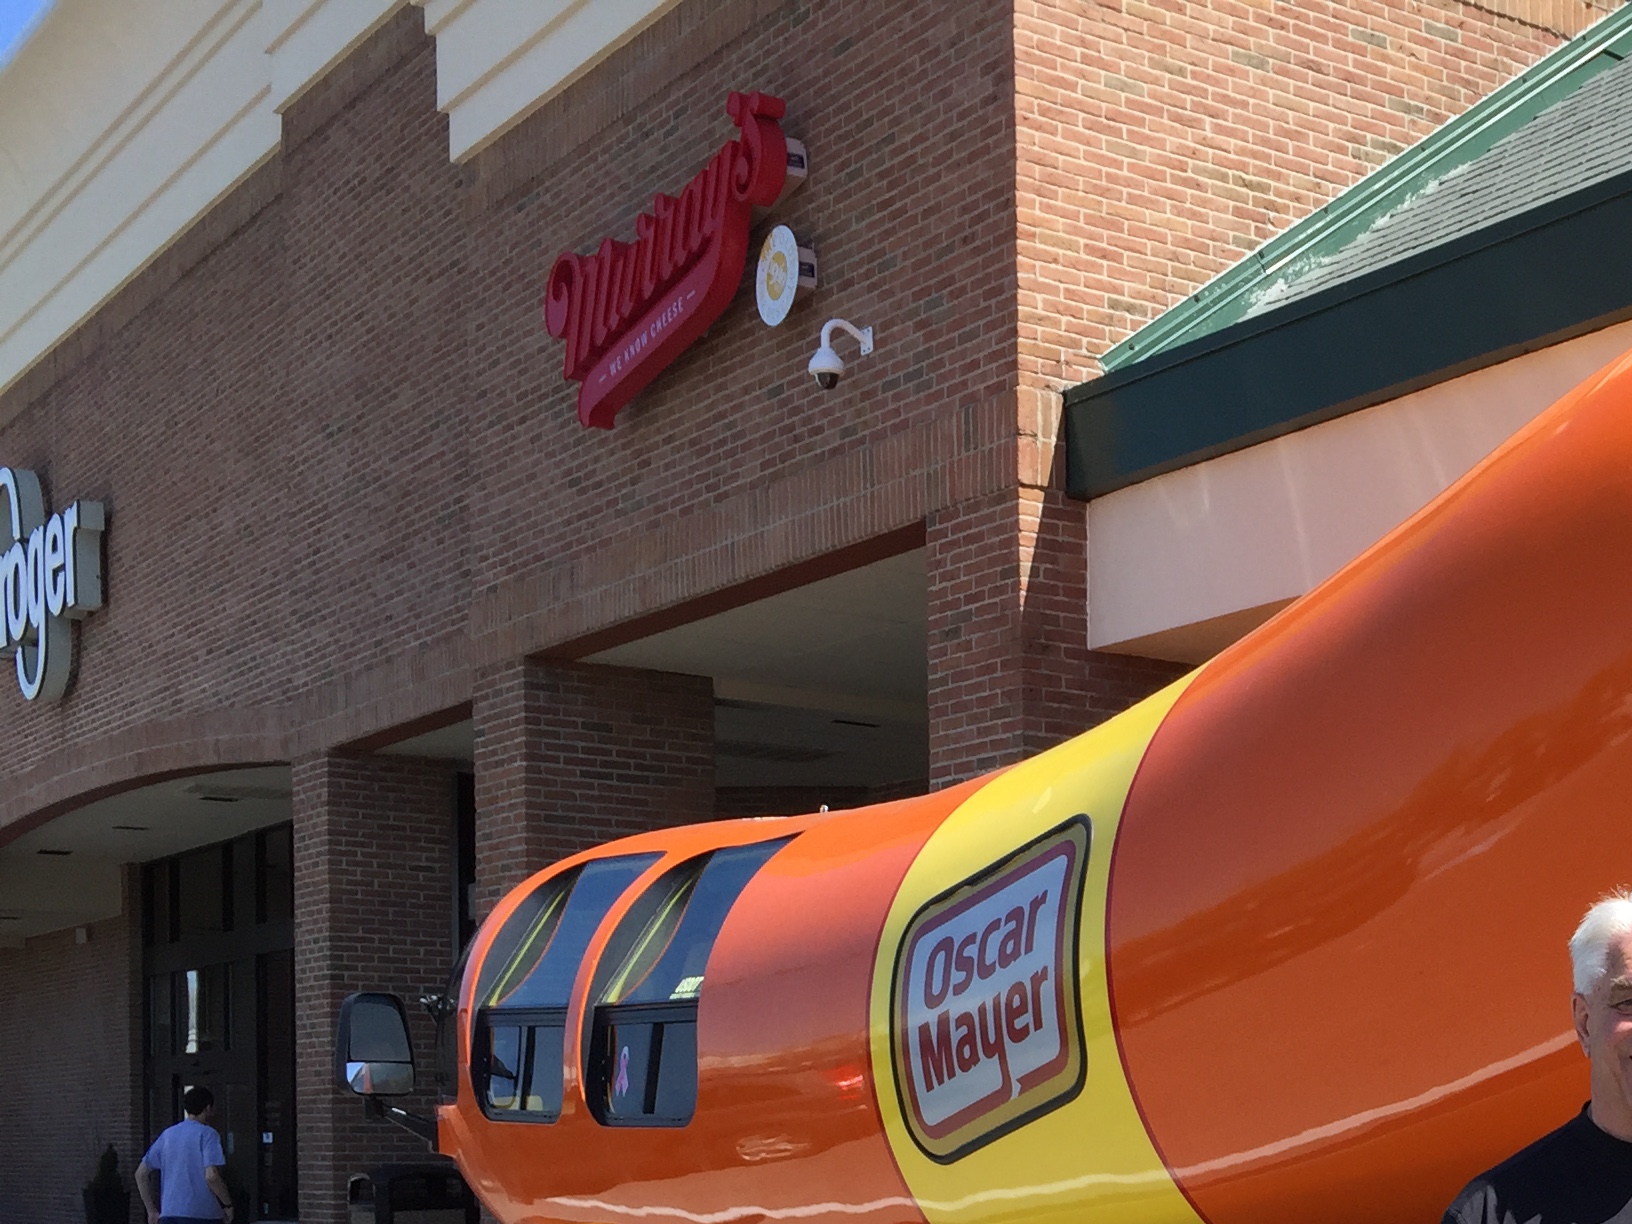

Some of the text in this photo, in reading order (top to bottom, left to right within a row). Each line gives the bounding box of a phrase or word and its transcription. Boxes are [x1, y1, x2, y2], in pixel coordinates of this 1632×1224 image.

[545, 92, 768, 380] Murray's
[609, 296, 683, 376] WE KNOW CHEESE
[924, 889, 1048, 1010] Oscar
[918, 966, 1048, 1096] Mayer
